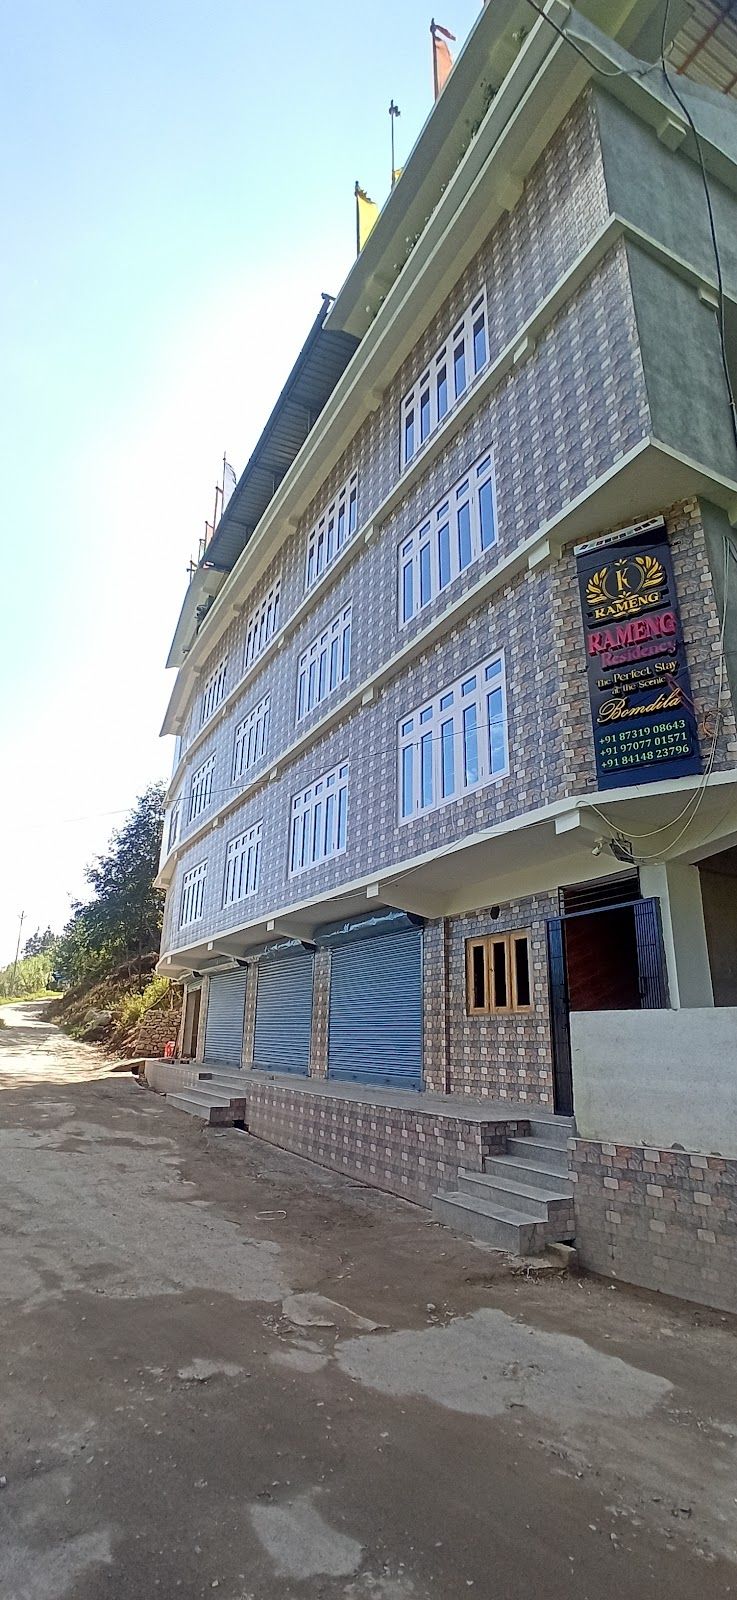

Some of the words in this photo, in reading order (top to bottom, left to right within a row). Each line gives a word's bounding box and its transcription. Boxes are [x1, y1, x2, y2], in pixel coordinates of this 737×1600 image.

[594, 592, 660, 619] RAMENG
[587, 612, 677, 654] RAMENG
[600, 640, 676, 668] Residency
[611, 685, 622, 695] at
[622, 682, 637, 692] the
[638, 675, 666, 689] Scenic
[613, 666, 652, 684] Perfect
[654, 660, 678, 673] Stay
[597, 688, 682, 723] Bomdila
[599, 733, 616, 745] +91
[618, 727, 651, 741] 87319
[652, 719, 686, 733] 08643
[600, 745, 618, 758] +91
[620, 739, 652, 752] 97077
[654, 731, 688, 745] 01571
[601, 759, 619, 769] +91
[621, 751, 654, 765] 84148
[656, 744, 690, 758] 23796
